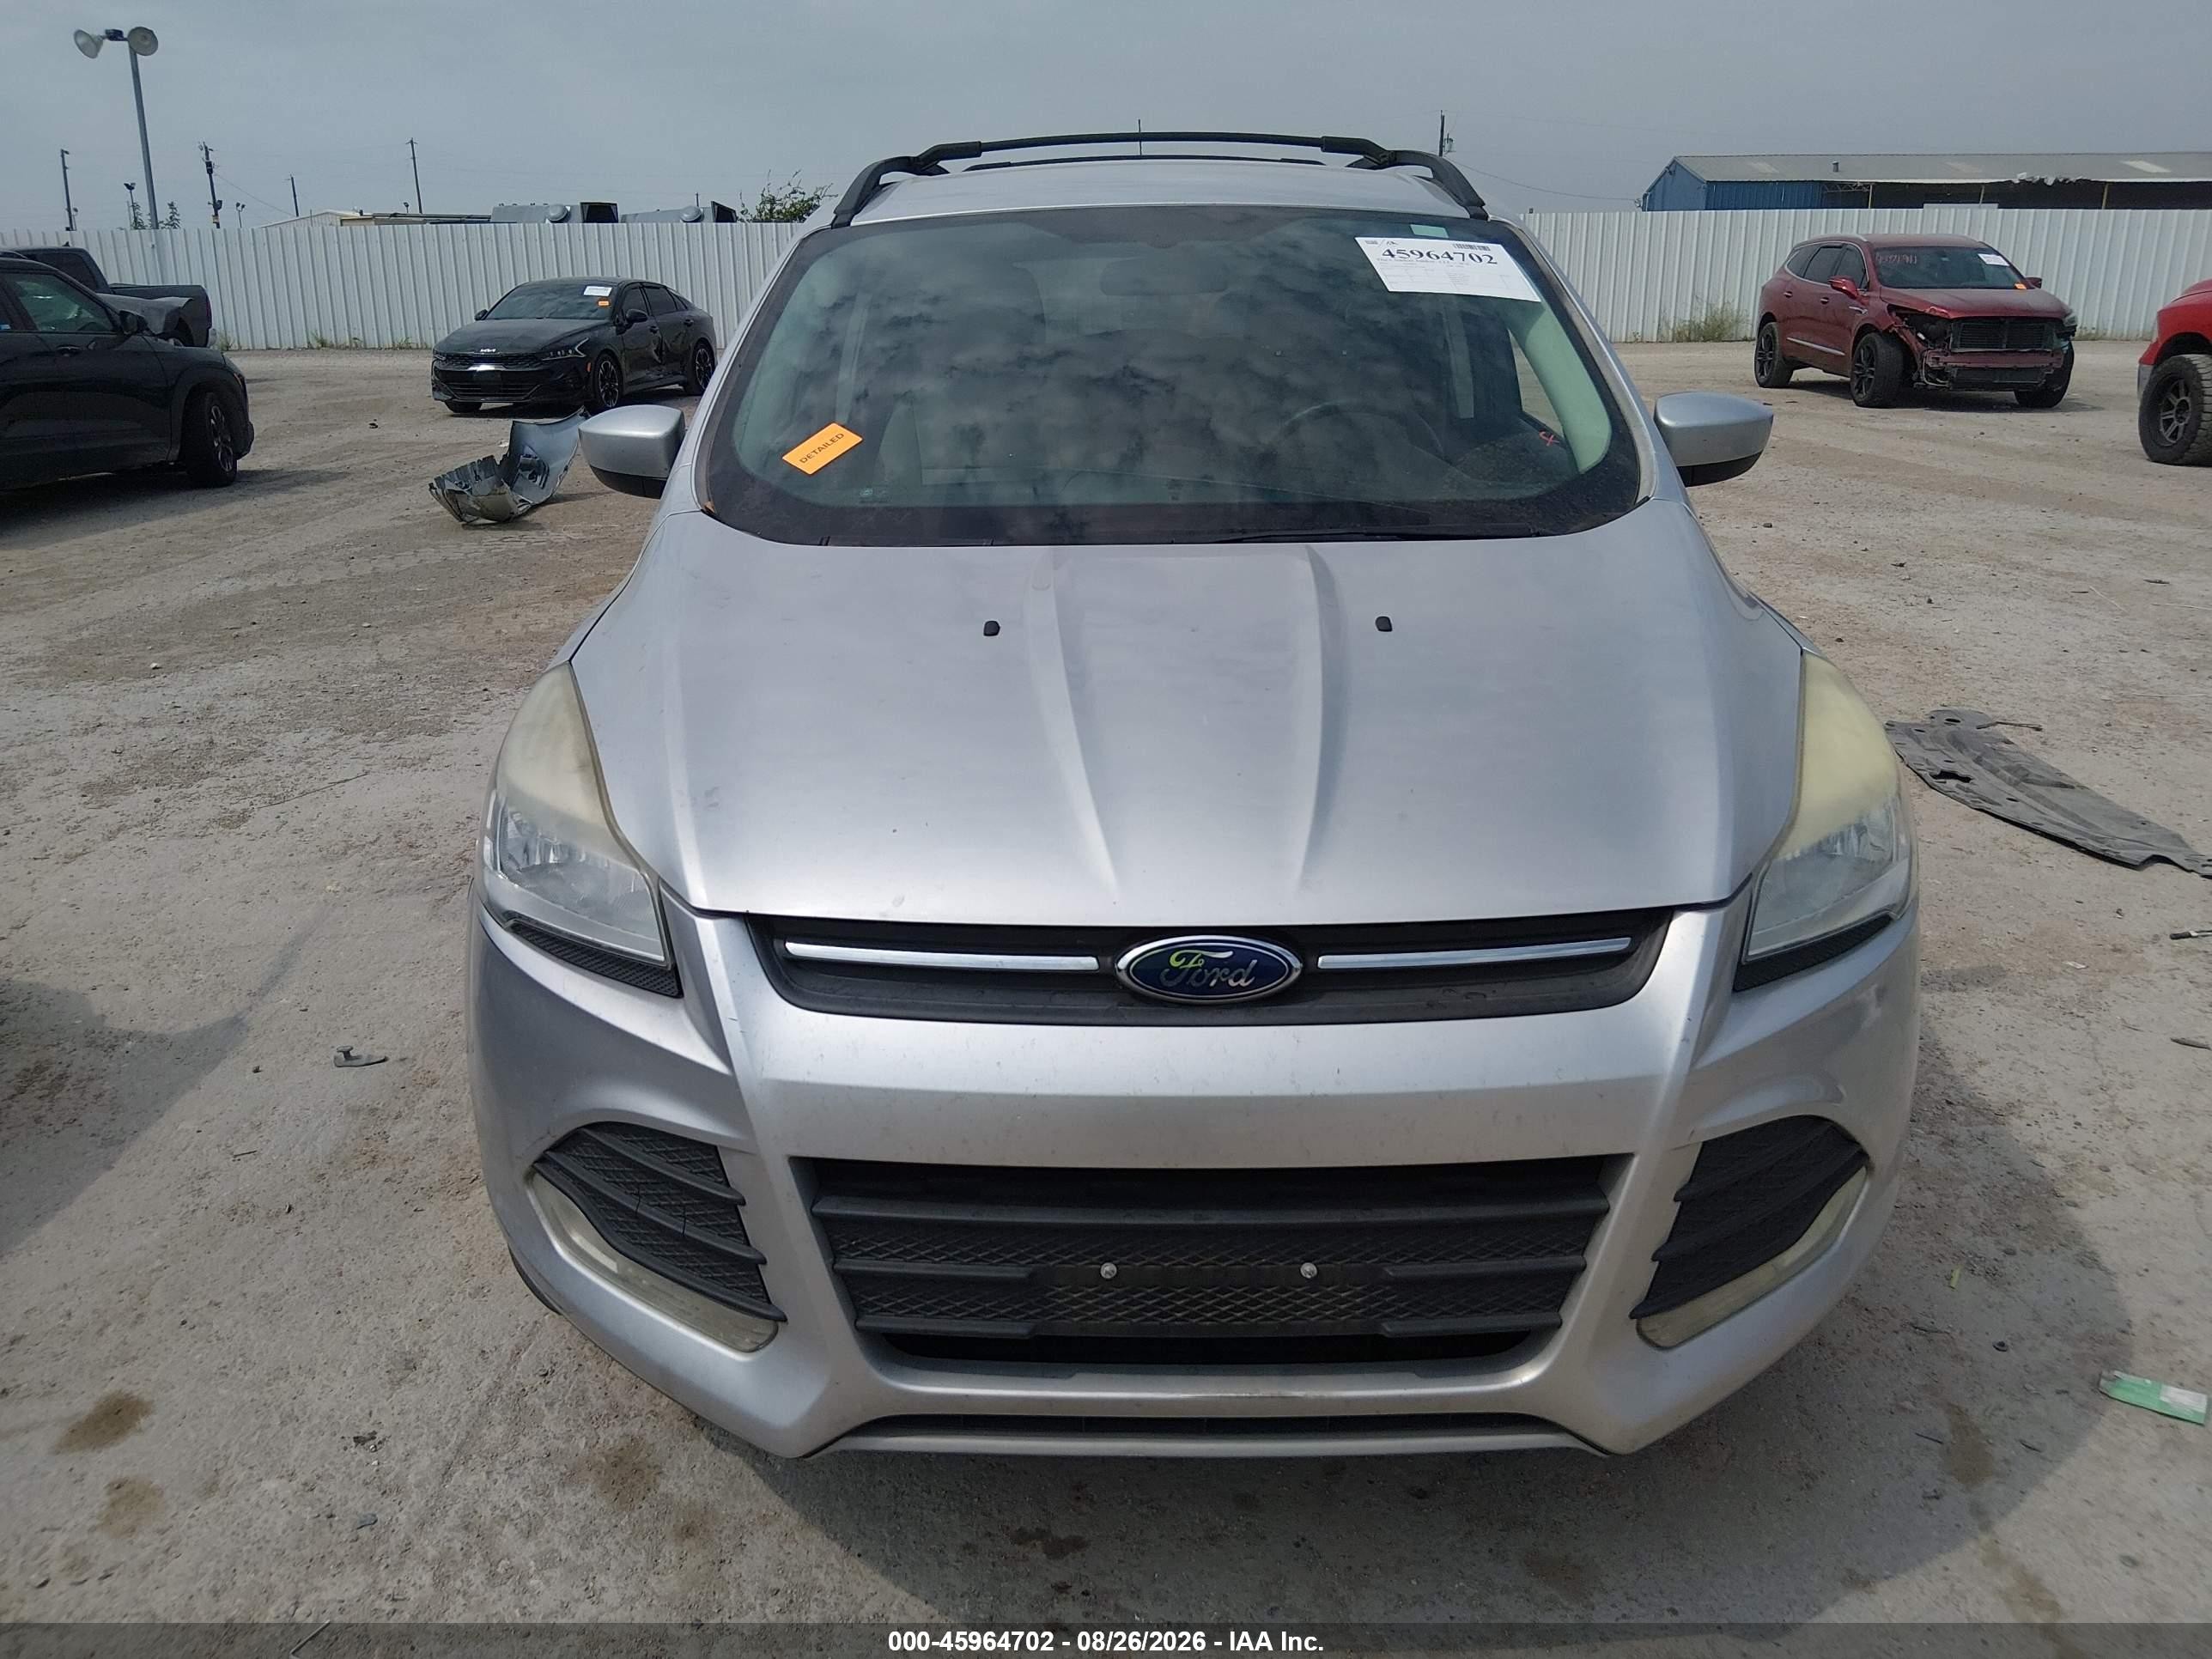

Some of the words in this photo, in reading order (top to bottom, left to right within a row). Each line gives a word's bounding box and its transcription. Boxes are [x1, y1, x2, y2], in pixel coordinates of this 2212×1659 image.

[1382, 247, 1498, 265] 45964702
[799, 433, 845, 464] DETAILED
[1159, 949, 1258, 988] Ford
